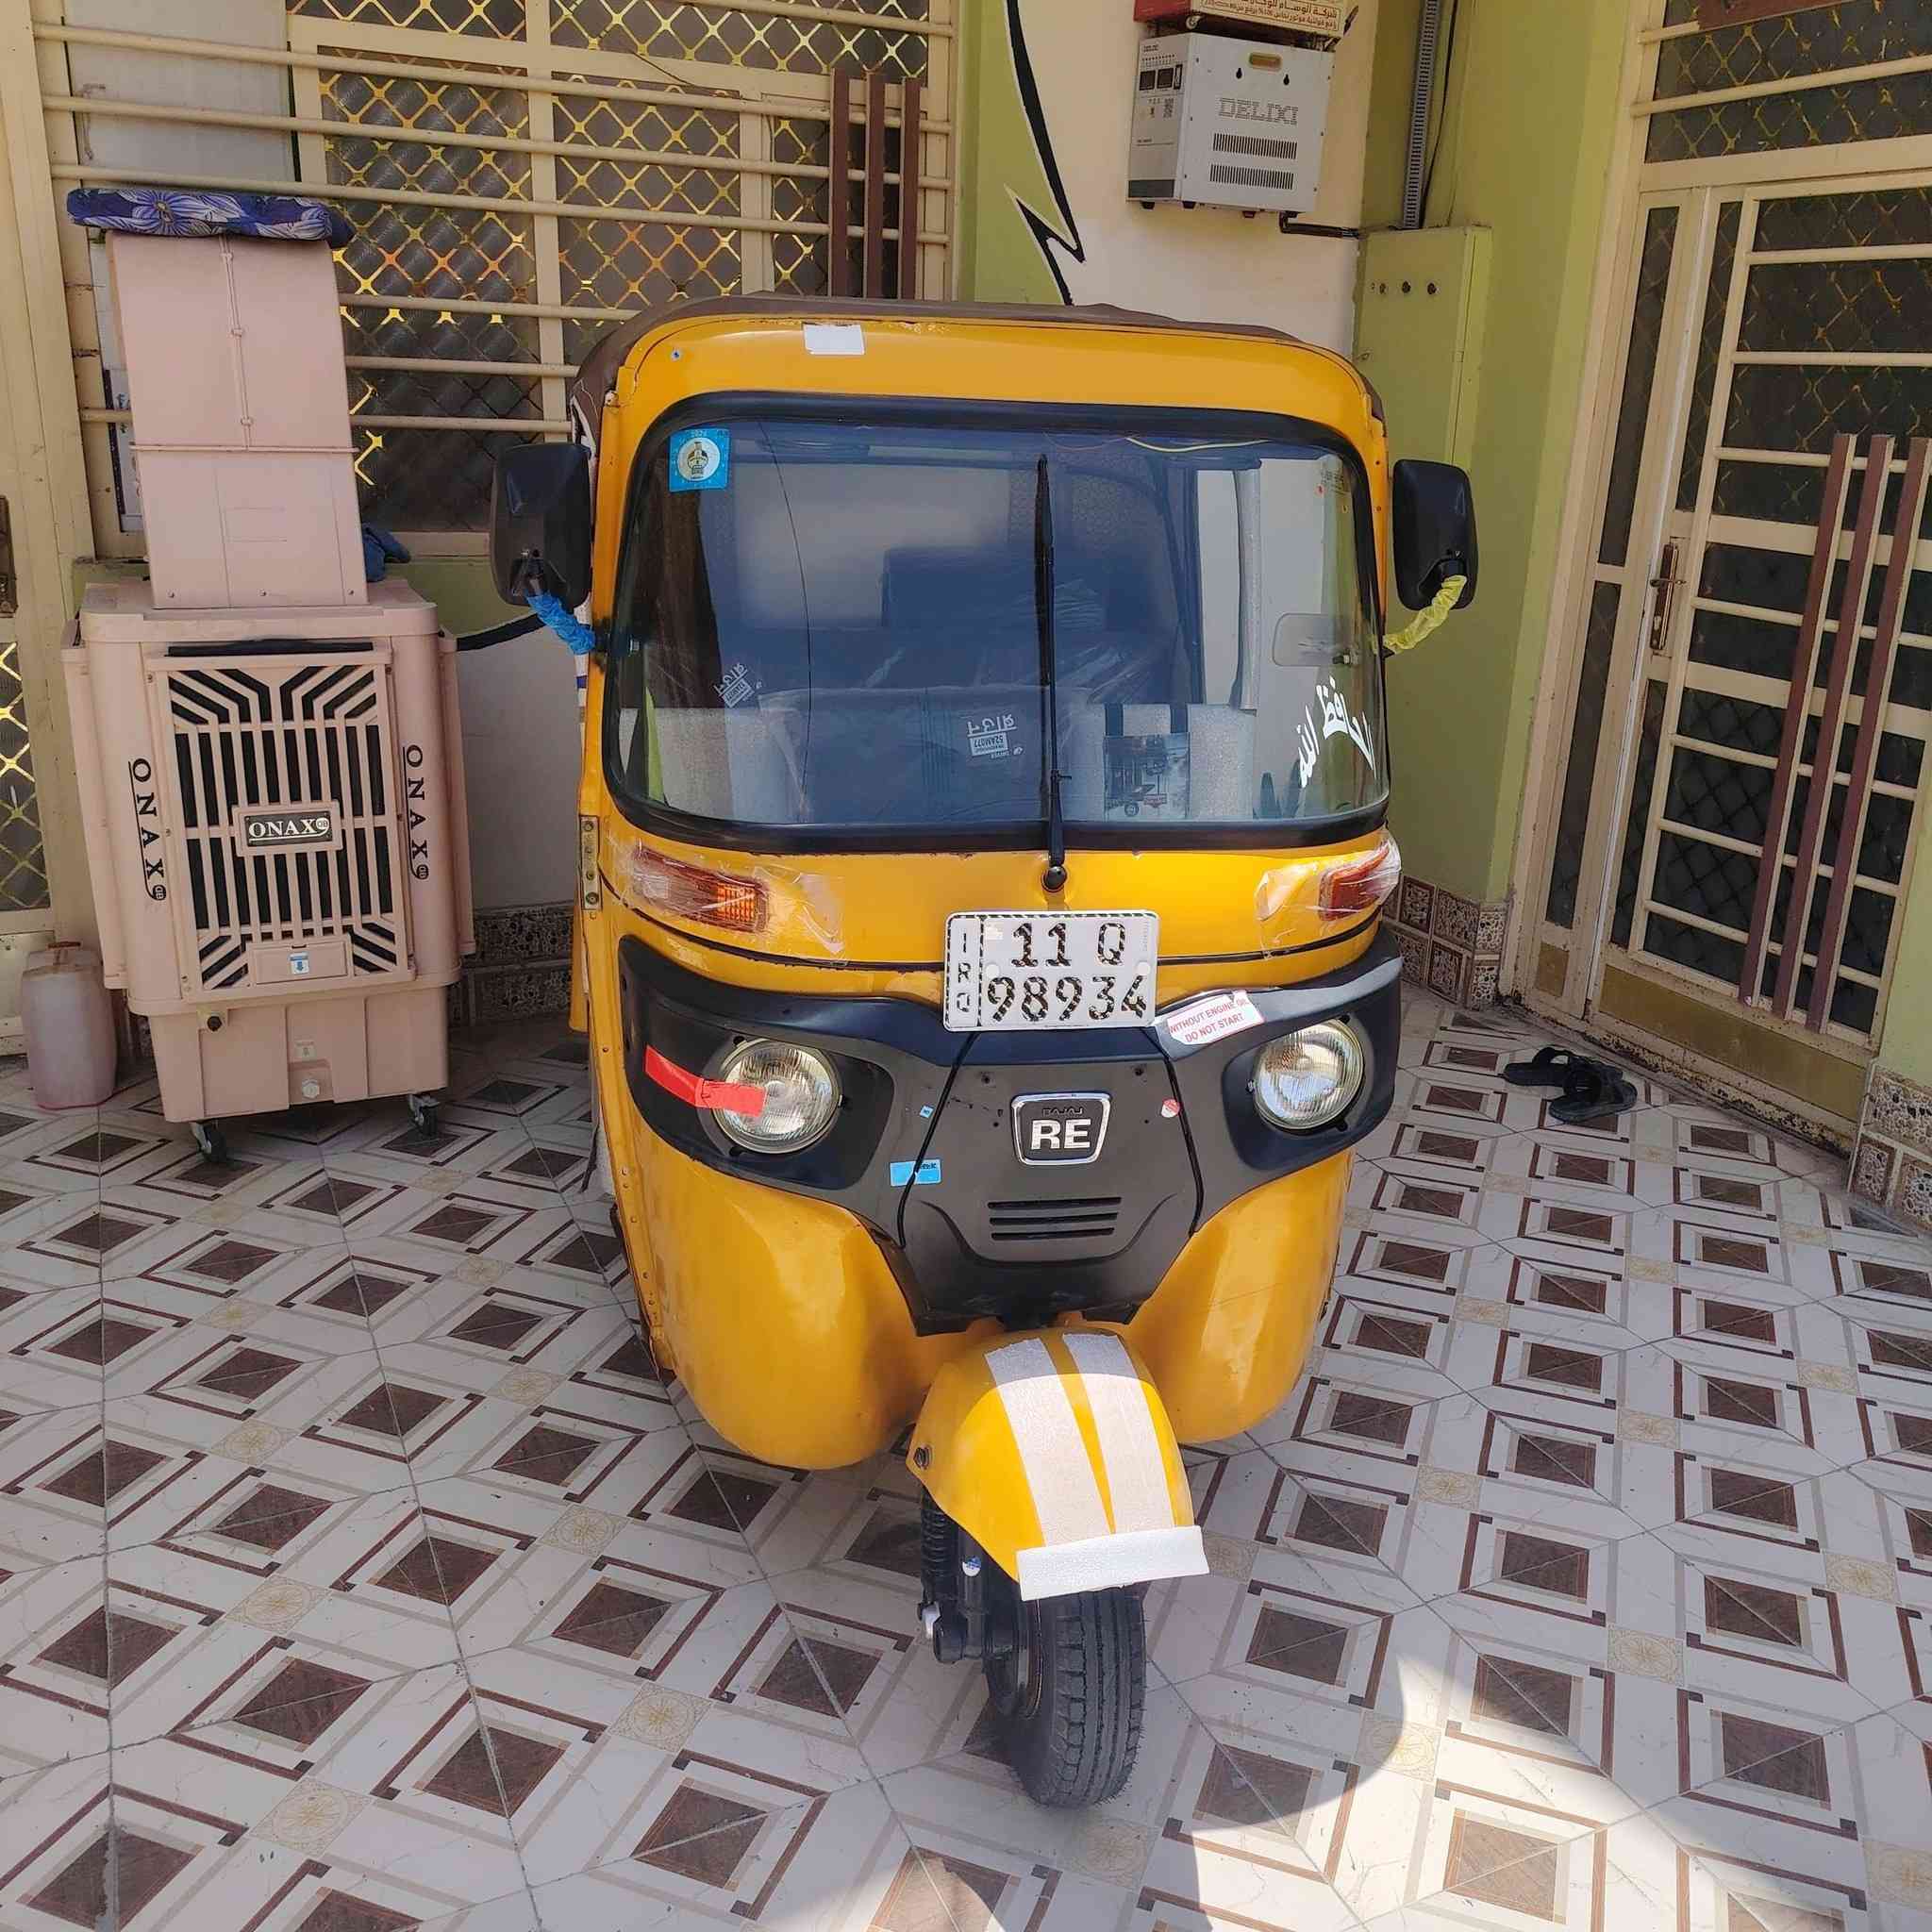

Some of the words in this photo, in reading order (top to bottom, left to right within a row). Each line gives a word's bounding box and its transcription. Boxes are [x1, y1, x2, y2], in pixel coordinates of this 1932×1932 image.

[248, 818, 317, 838] ONAX
[1011, 922, 1072, 968] 11
[1096, 922, 1126, 966] Q
[987, 974, 1148, 1022] 98934
[1170, 1013, 1206, 1033] WITHOUT
[1205, 1002, 1237, 1018] ENGINE
[1185, 1030, 1198, 1042] DO
[1199, 1023, 1218, 1037] NOT
[1219, 1012, 1244, 1028] START
[1031, 1118, 1091, 1150] RE
